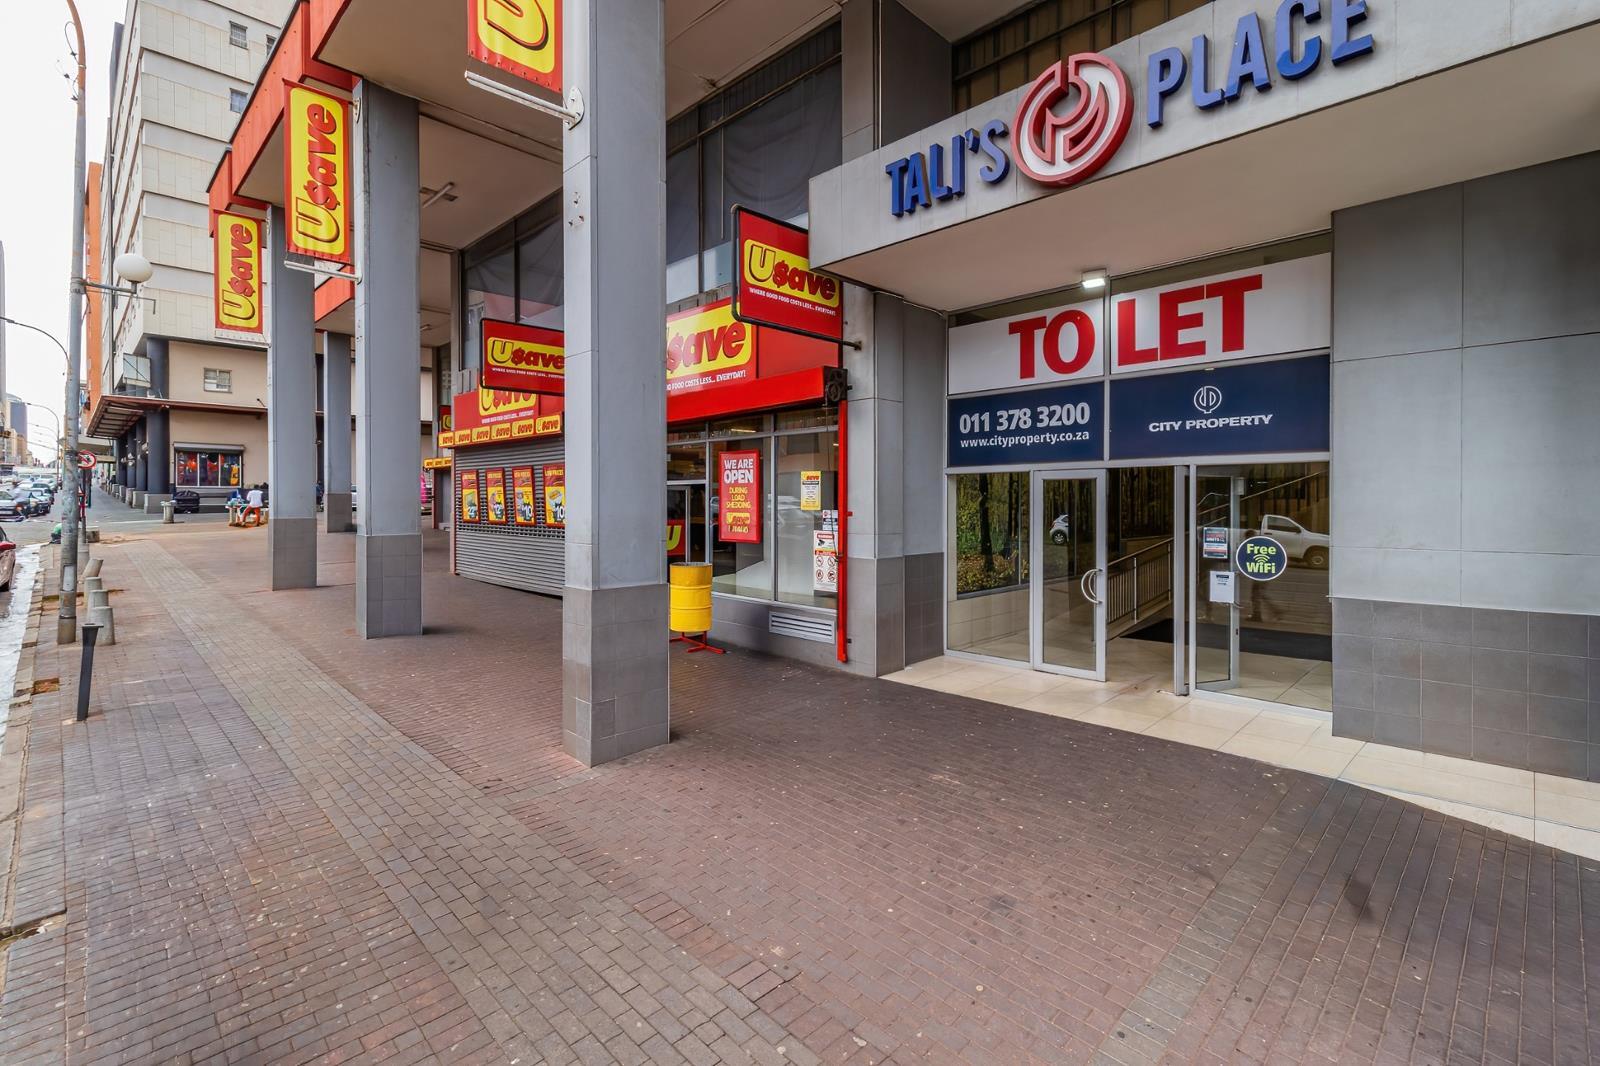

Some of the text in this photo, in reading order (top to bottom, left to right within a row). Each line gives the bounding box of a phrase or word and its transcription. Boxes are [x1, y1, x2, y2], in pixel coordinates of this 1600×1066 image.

[885, 0, 1374, 217] TALI'S PLACE
[1008, 274, 1263, 379] TO LET
[959, 402, 1090, 435] 011 378 3200
[1148, 413, 1273, 433] CITY PROPERTY
[960, 430, 1090, 448] www.cityproperty.co.za
[723, 458, 753, 470] WE ARE
[723, 469, 753, 484] OPEN
[1246, 543, 1277, 555] Free
[1246, 562, 1276, 574] WiFi
